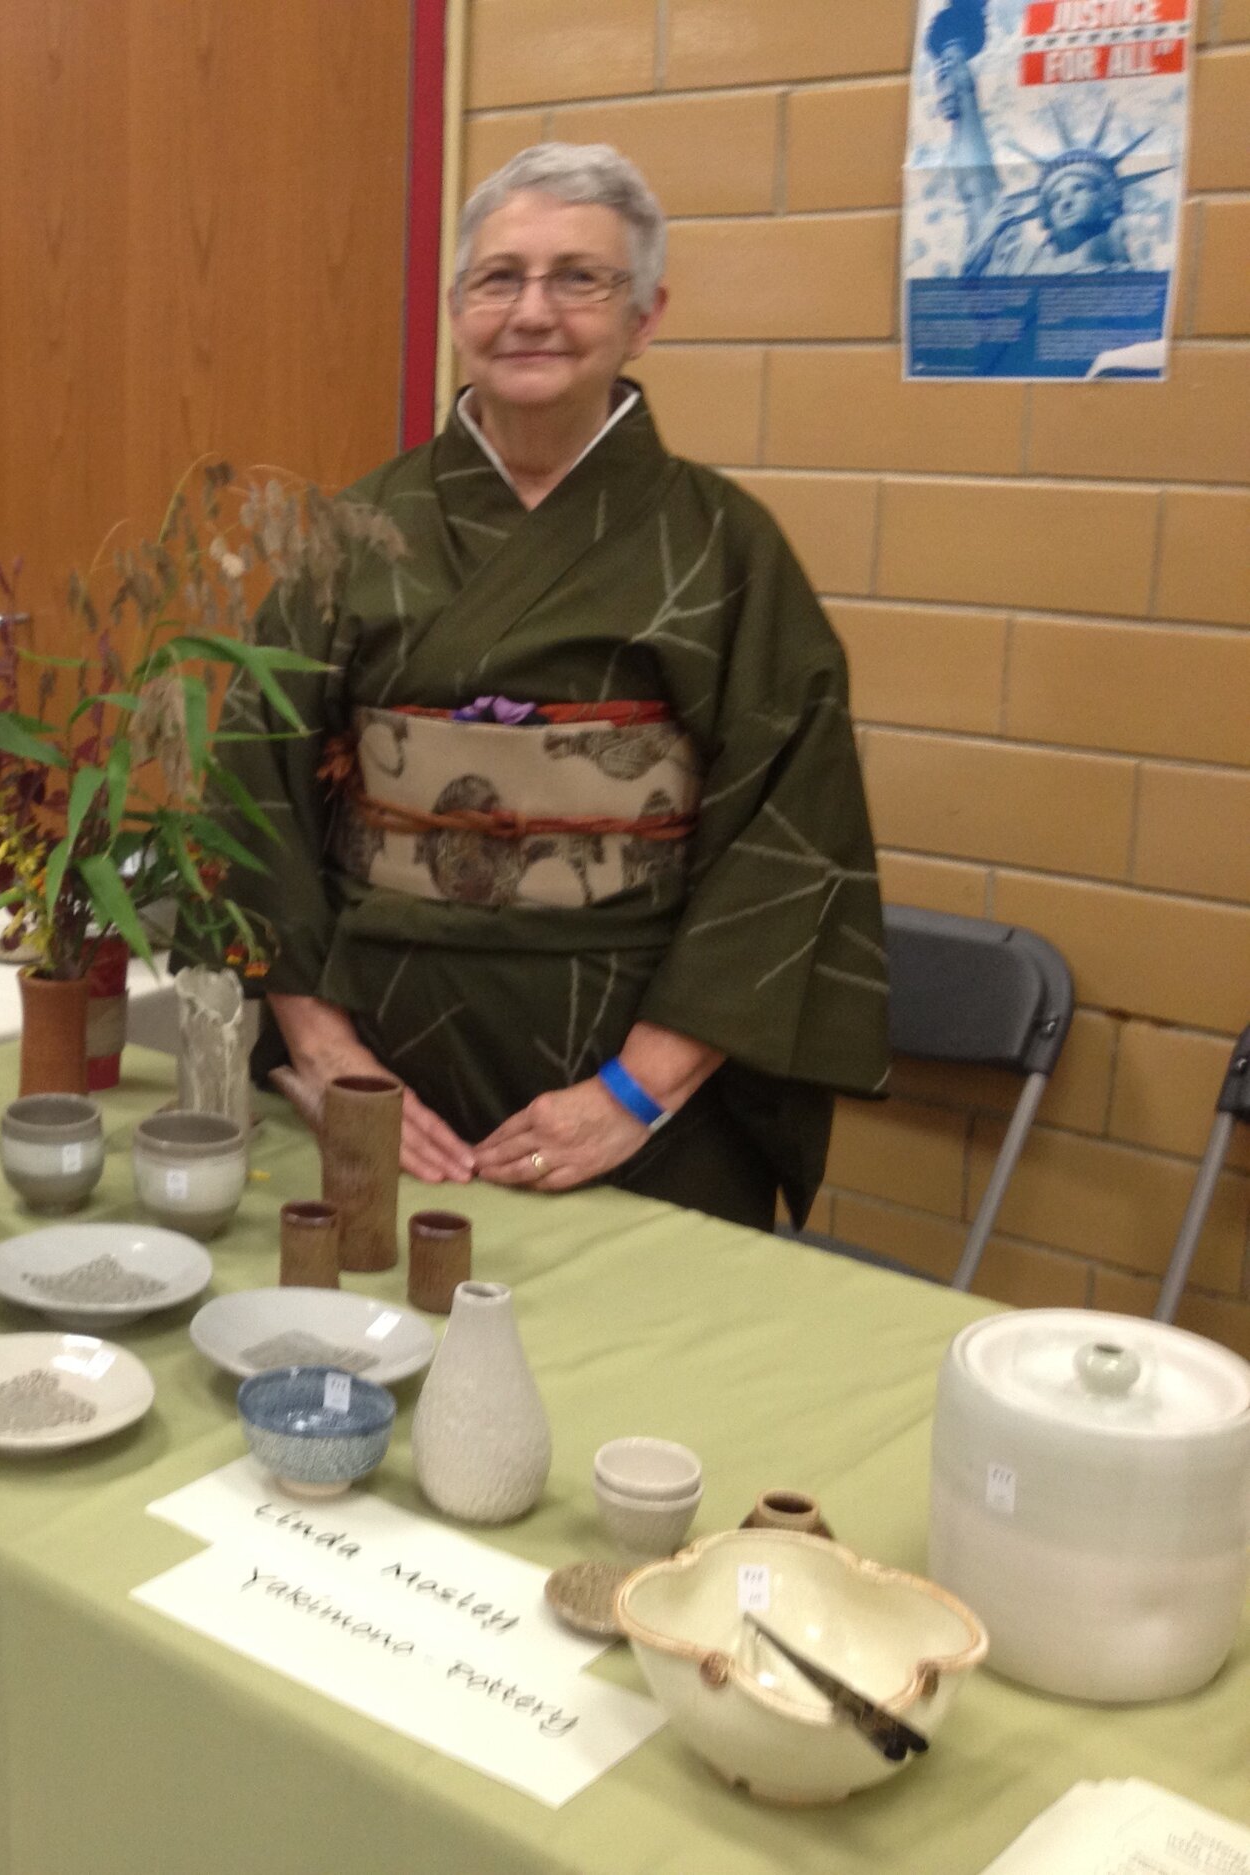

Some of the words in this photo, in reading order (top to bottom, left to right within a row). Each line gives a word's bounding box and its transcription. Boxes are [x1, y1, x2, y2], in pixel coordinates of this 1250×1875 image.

[1044, 49, 1099, 83] FOR
[1105, 41, 1161, 77] ALL
[255, 1502, 361, 1559] Linda
[447, 1660, 580, 1738] Pottery
